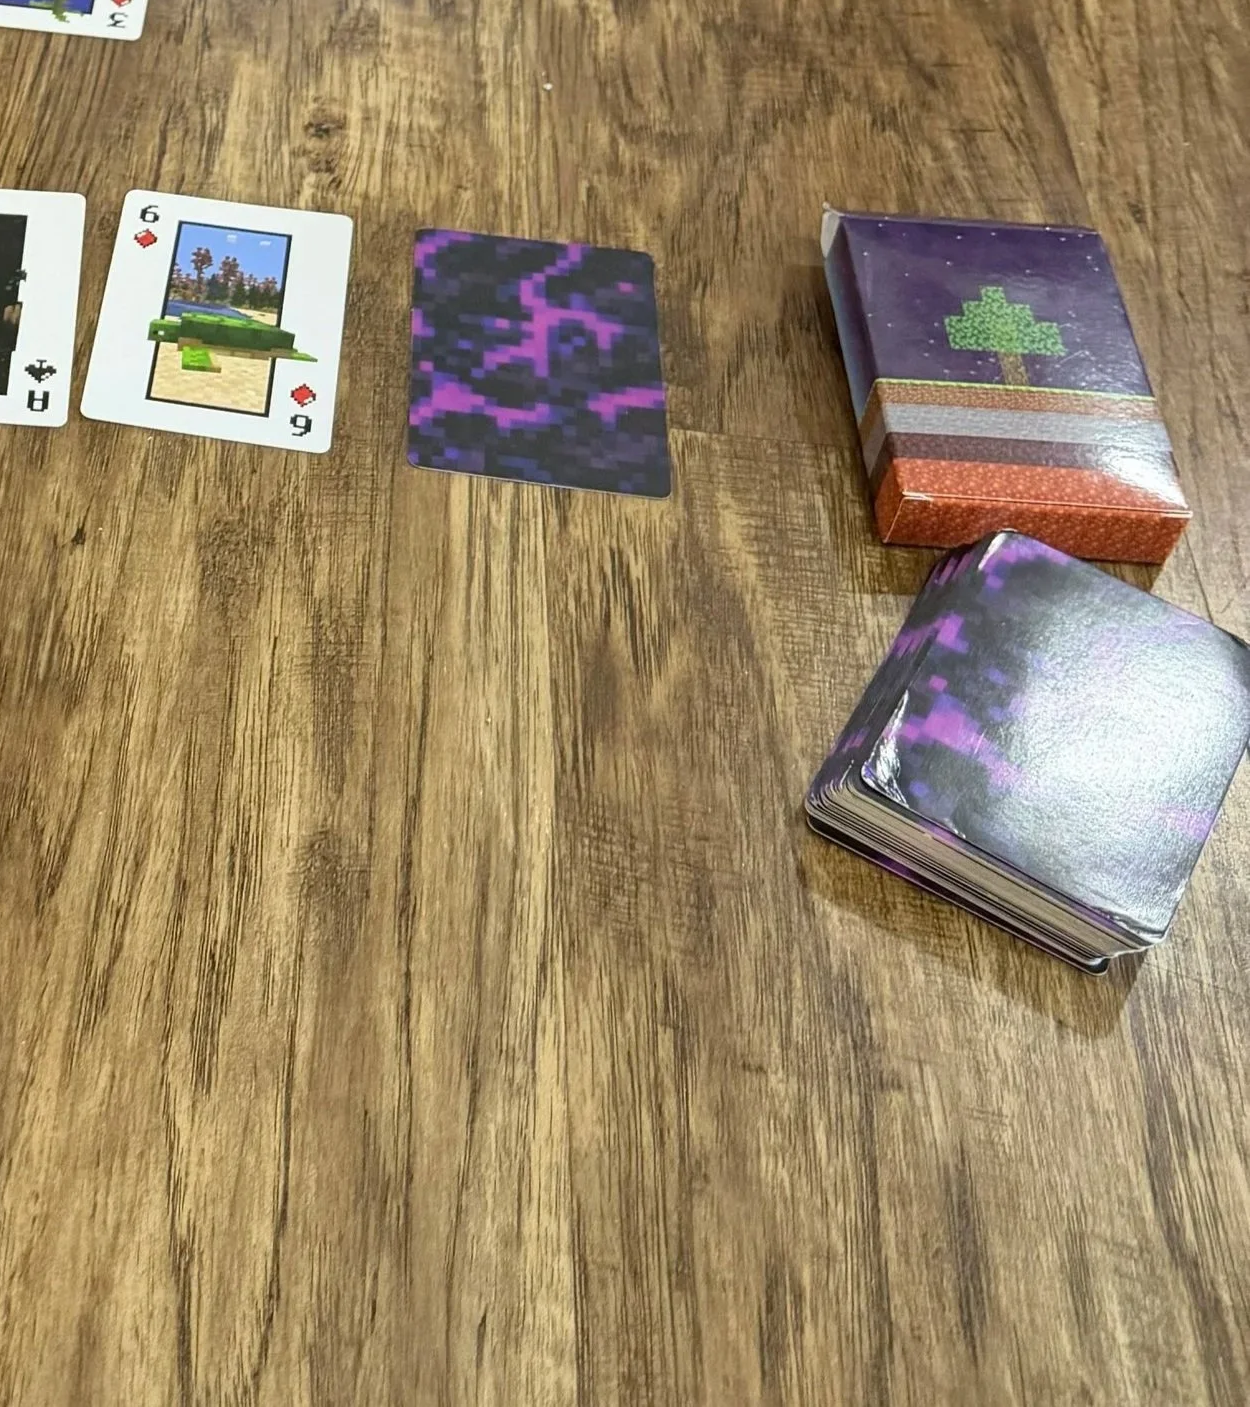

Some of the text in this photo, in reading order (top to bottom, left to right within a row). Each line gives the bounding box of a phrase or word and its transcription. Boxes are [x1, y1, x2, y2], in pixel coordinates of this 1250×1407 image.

[107, 12, 129, 28] 3
[139, 204, 160, 224] 6
[27, 390, 50, 413] A
[290, 414, 313, 437] 6
